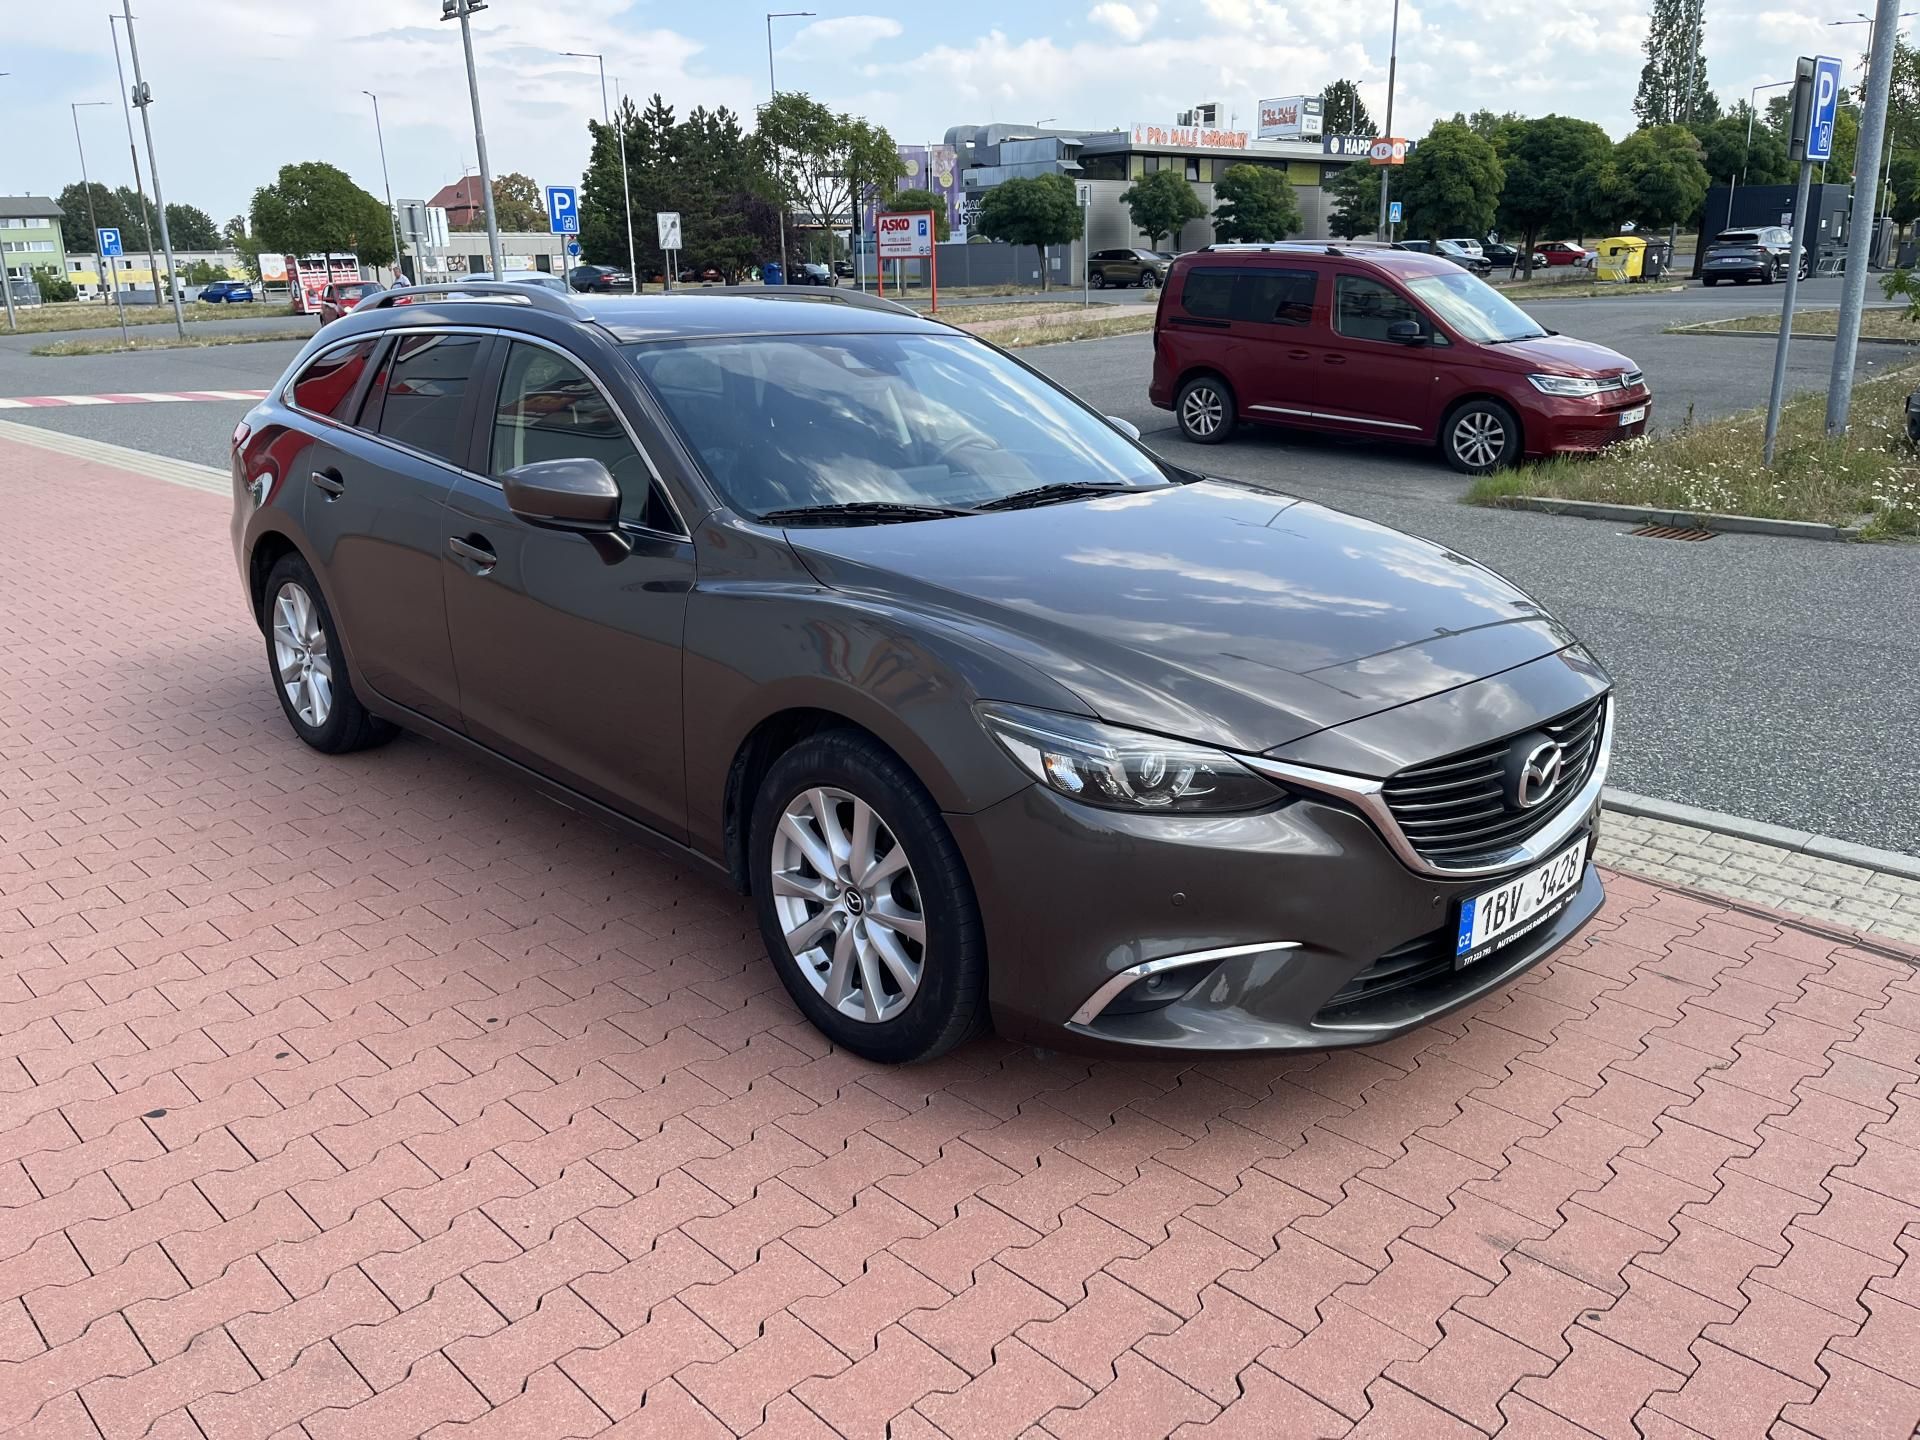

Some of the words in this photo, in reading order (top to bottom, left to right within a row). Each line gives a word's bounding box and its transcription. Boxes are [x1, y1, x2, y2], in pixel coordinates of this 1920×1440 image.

[1815, 71, 1834, 128] P
[1171, 127, 1198, 147] MALÉ
[1344, 138, 1372, 155] HAPP
[1376, 146, 1387, 157] 16
[553, 192, 571, 220] P
[881, 218, 910, 231] ASKO
[103, 232, 116, 248] P
[1482, 883, 1524, 936] 1BV
[1536, 846, 1579, 905] 3428
[1458, 932, 1471, 948] CZ
[1496, 922, 1533, 950] AUTOSERVIS
